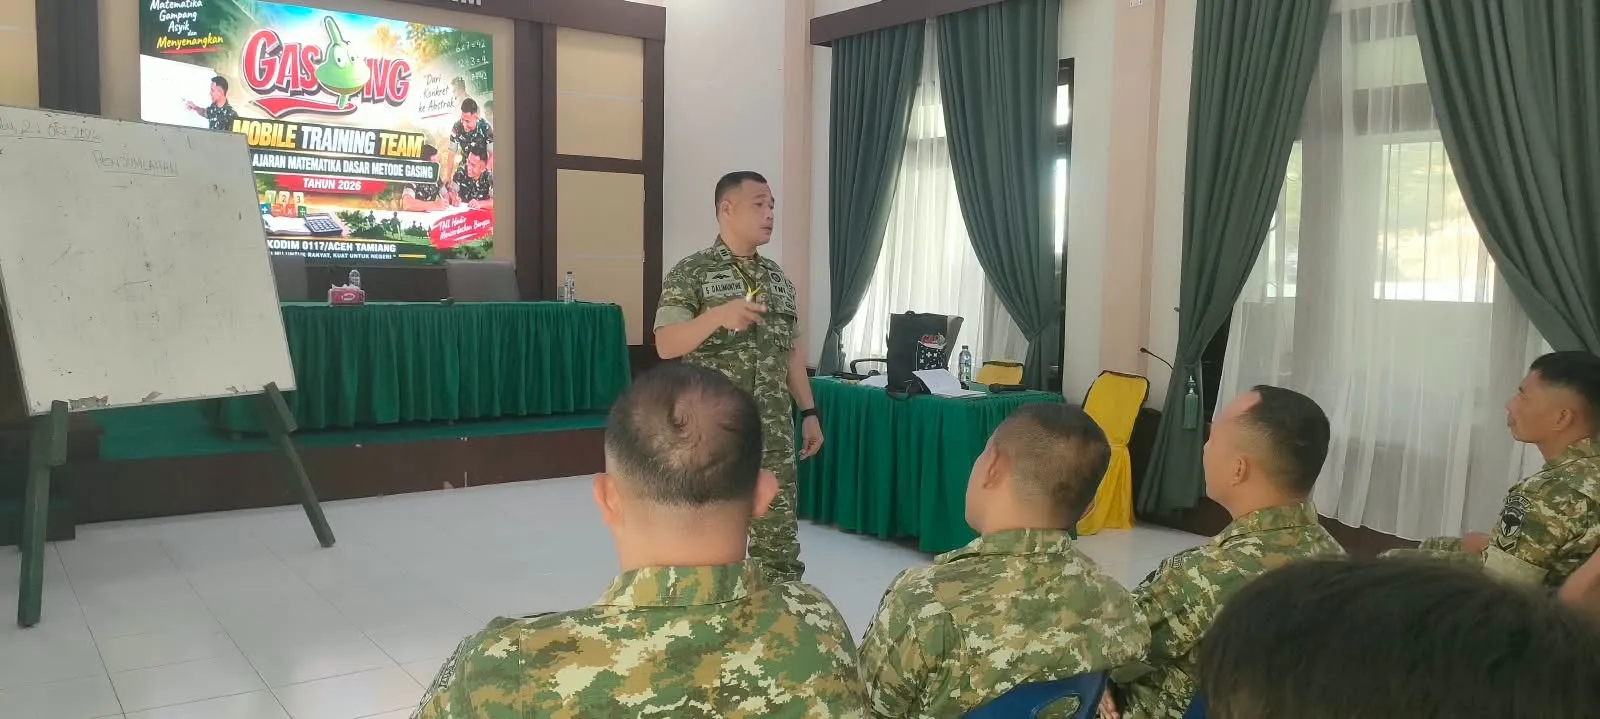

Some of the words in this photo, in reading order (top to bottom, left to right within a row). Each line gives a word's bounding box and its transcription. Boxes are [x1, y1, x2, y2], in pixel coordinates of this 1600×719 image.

[150, 0, 203, 11] Matematika
[159, 9, 198, 22] Gampang
[168, 20, 190, 34] Asyik
[156, 32, 224, 50] Menyenangkan
[232, 119, 298, 149] MOBILE
[301, 125, 376, 155] TRAINING
[379, 132, 424, 158] TEAM
[287, 156, 342, 173] MATEMATIKA
[343, 160, 370, 174] DASAR
[371, 162, 404, 177] METODE
[405, 165, 433, 180] GASING
[303, 177, 336, 190] TAHUN
[337, 179, 362, 191] 2026
[266, 239, 300, 250] KODIM
[302, 240, 353, 252] 0117/ACEH
[355, 243, 397, 253] TAMIANG
